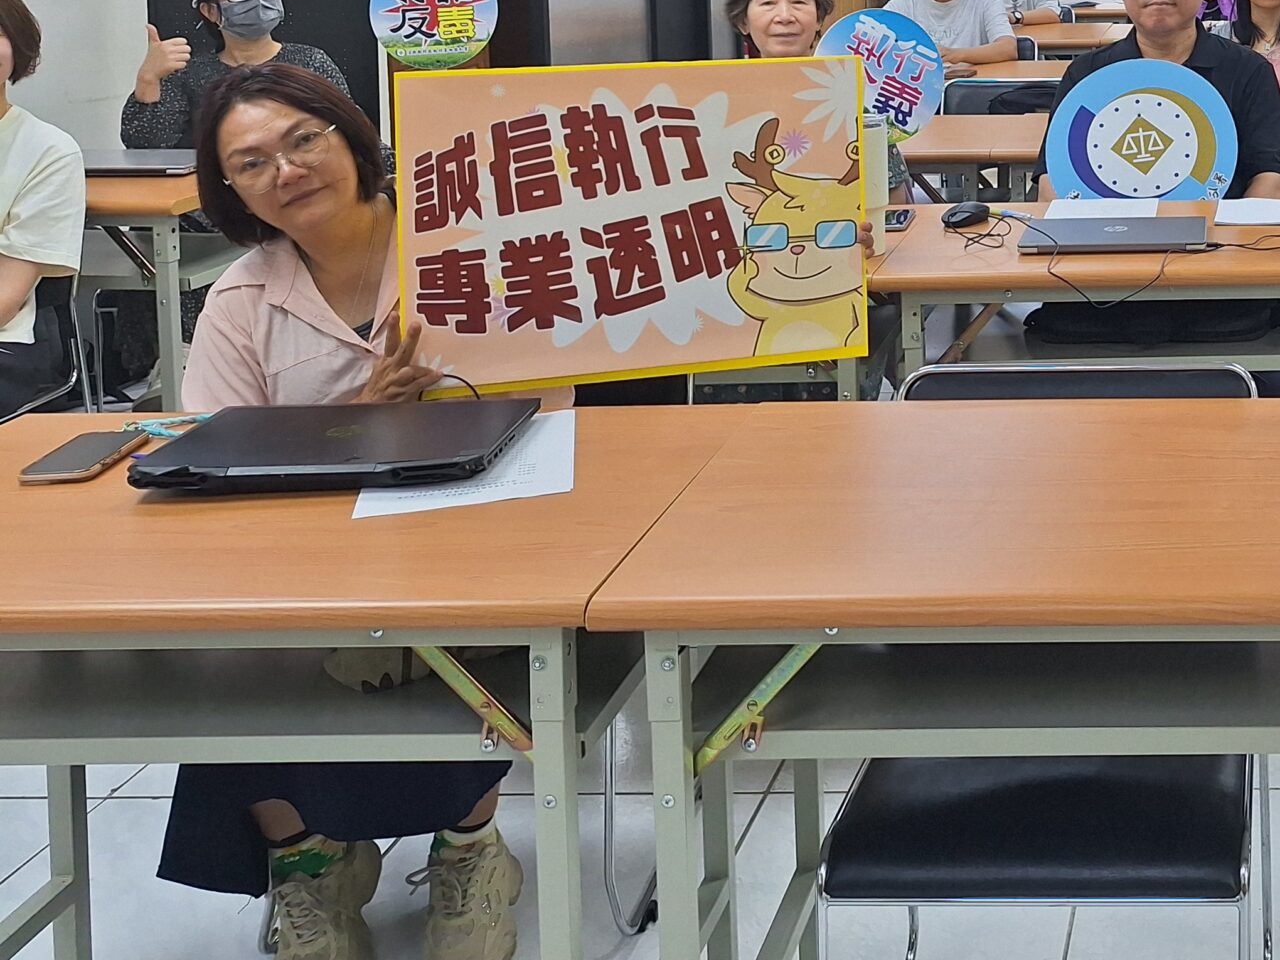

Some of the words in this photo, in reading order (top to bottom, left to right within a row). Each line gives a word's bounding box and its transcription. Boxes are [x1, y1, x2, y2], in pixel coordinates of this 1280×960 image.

[389, 6, 476, 40] 反毒
[847, 14, 939, 83] 執行
[413, 103, 709, 234] 誠信執行
[415, 196, 745, 334] 專業透明
